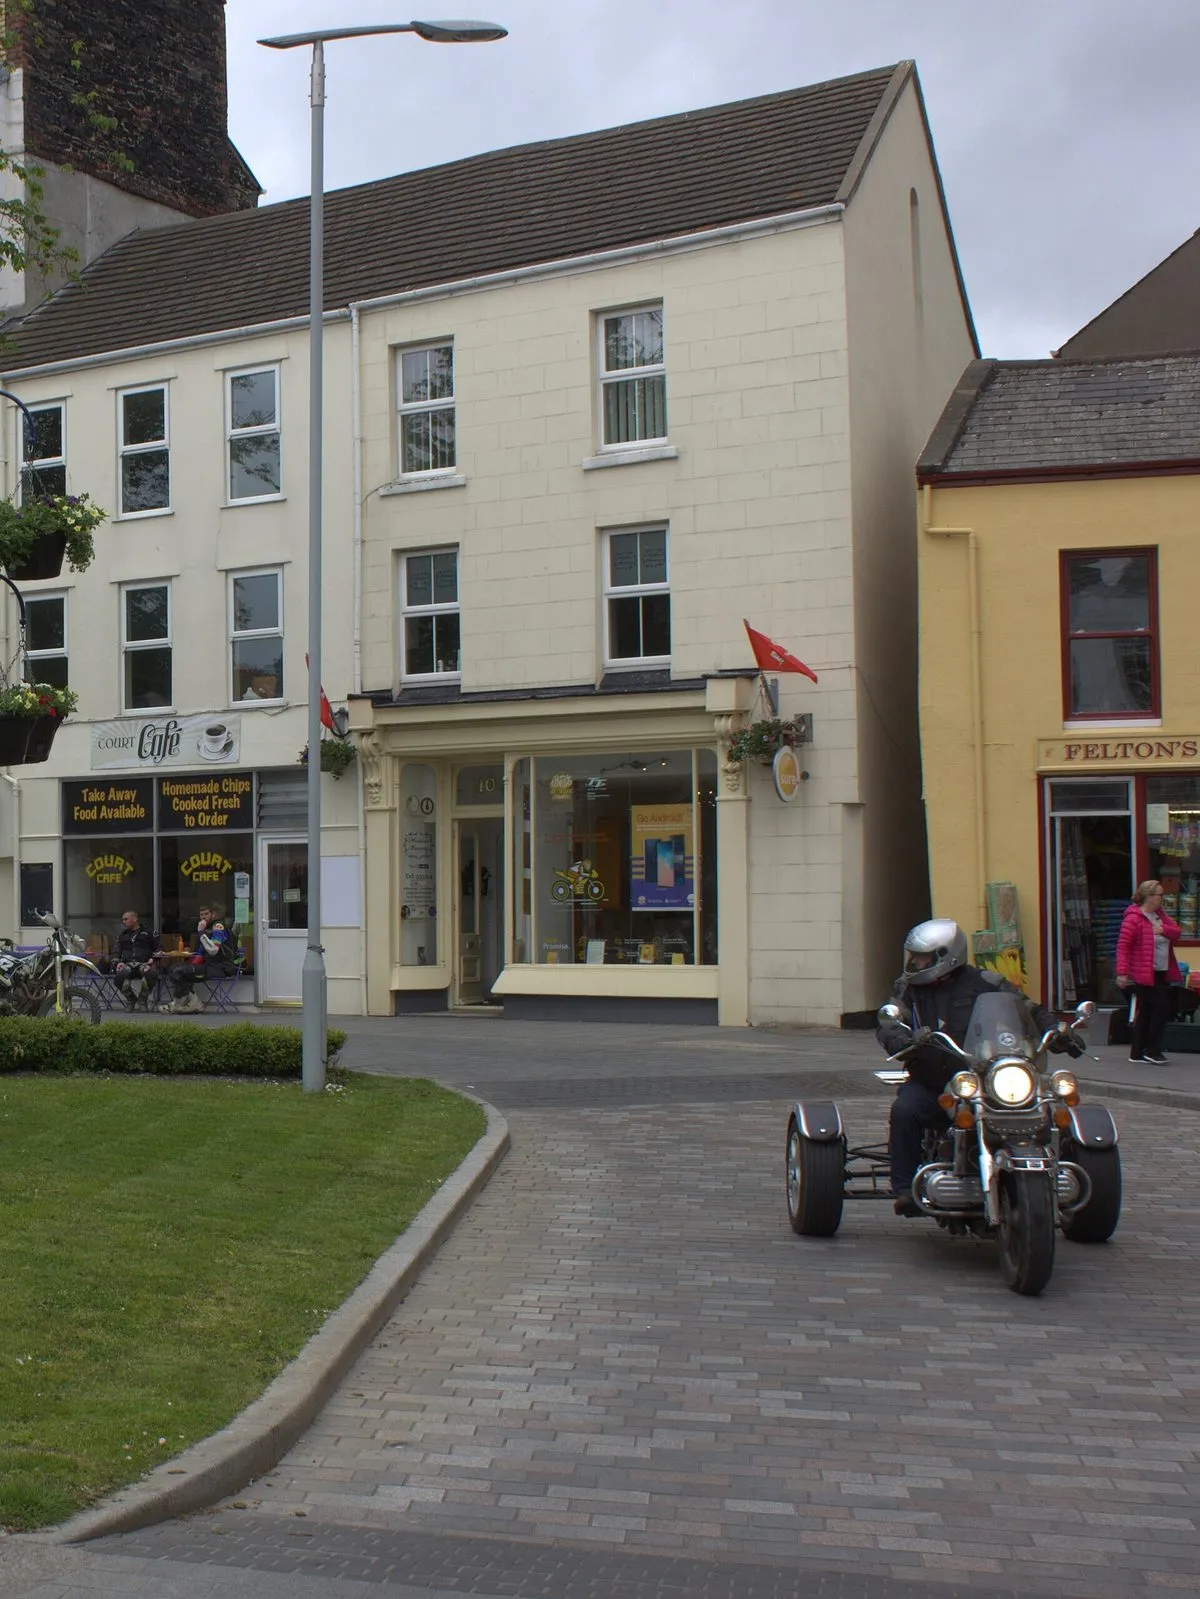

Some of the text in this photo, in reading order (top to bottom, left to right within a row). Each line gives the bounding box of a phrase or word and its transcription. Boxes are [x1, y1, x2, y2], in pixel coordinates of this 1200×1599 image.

[98, 720, 183, 764] COURT Café
[1063, 740, 1198, 761] FELTON'S
[162, 778, 250, 796] Homemade Chips
[479, 777, 495, 793] 10
[81, 787, 137, 803] Take Away
[172, 793, 241, 811] Cooked Fresh
[73, 804, 145, 820] Food Available
[184, 811, 229, 828] to Order
[637, 814, 649, 823] Go
[85, 854, 135, 879] COURT
[179, 852, 232, 877] COURT
[96, 873, 123, 884] CAFE
[192, 871, 219, 882] CAFE
